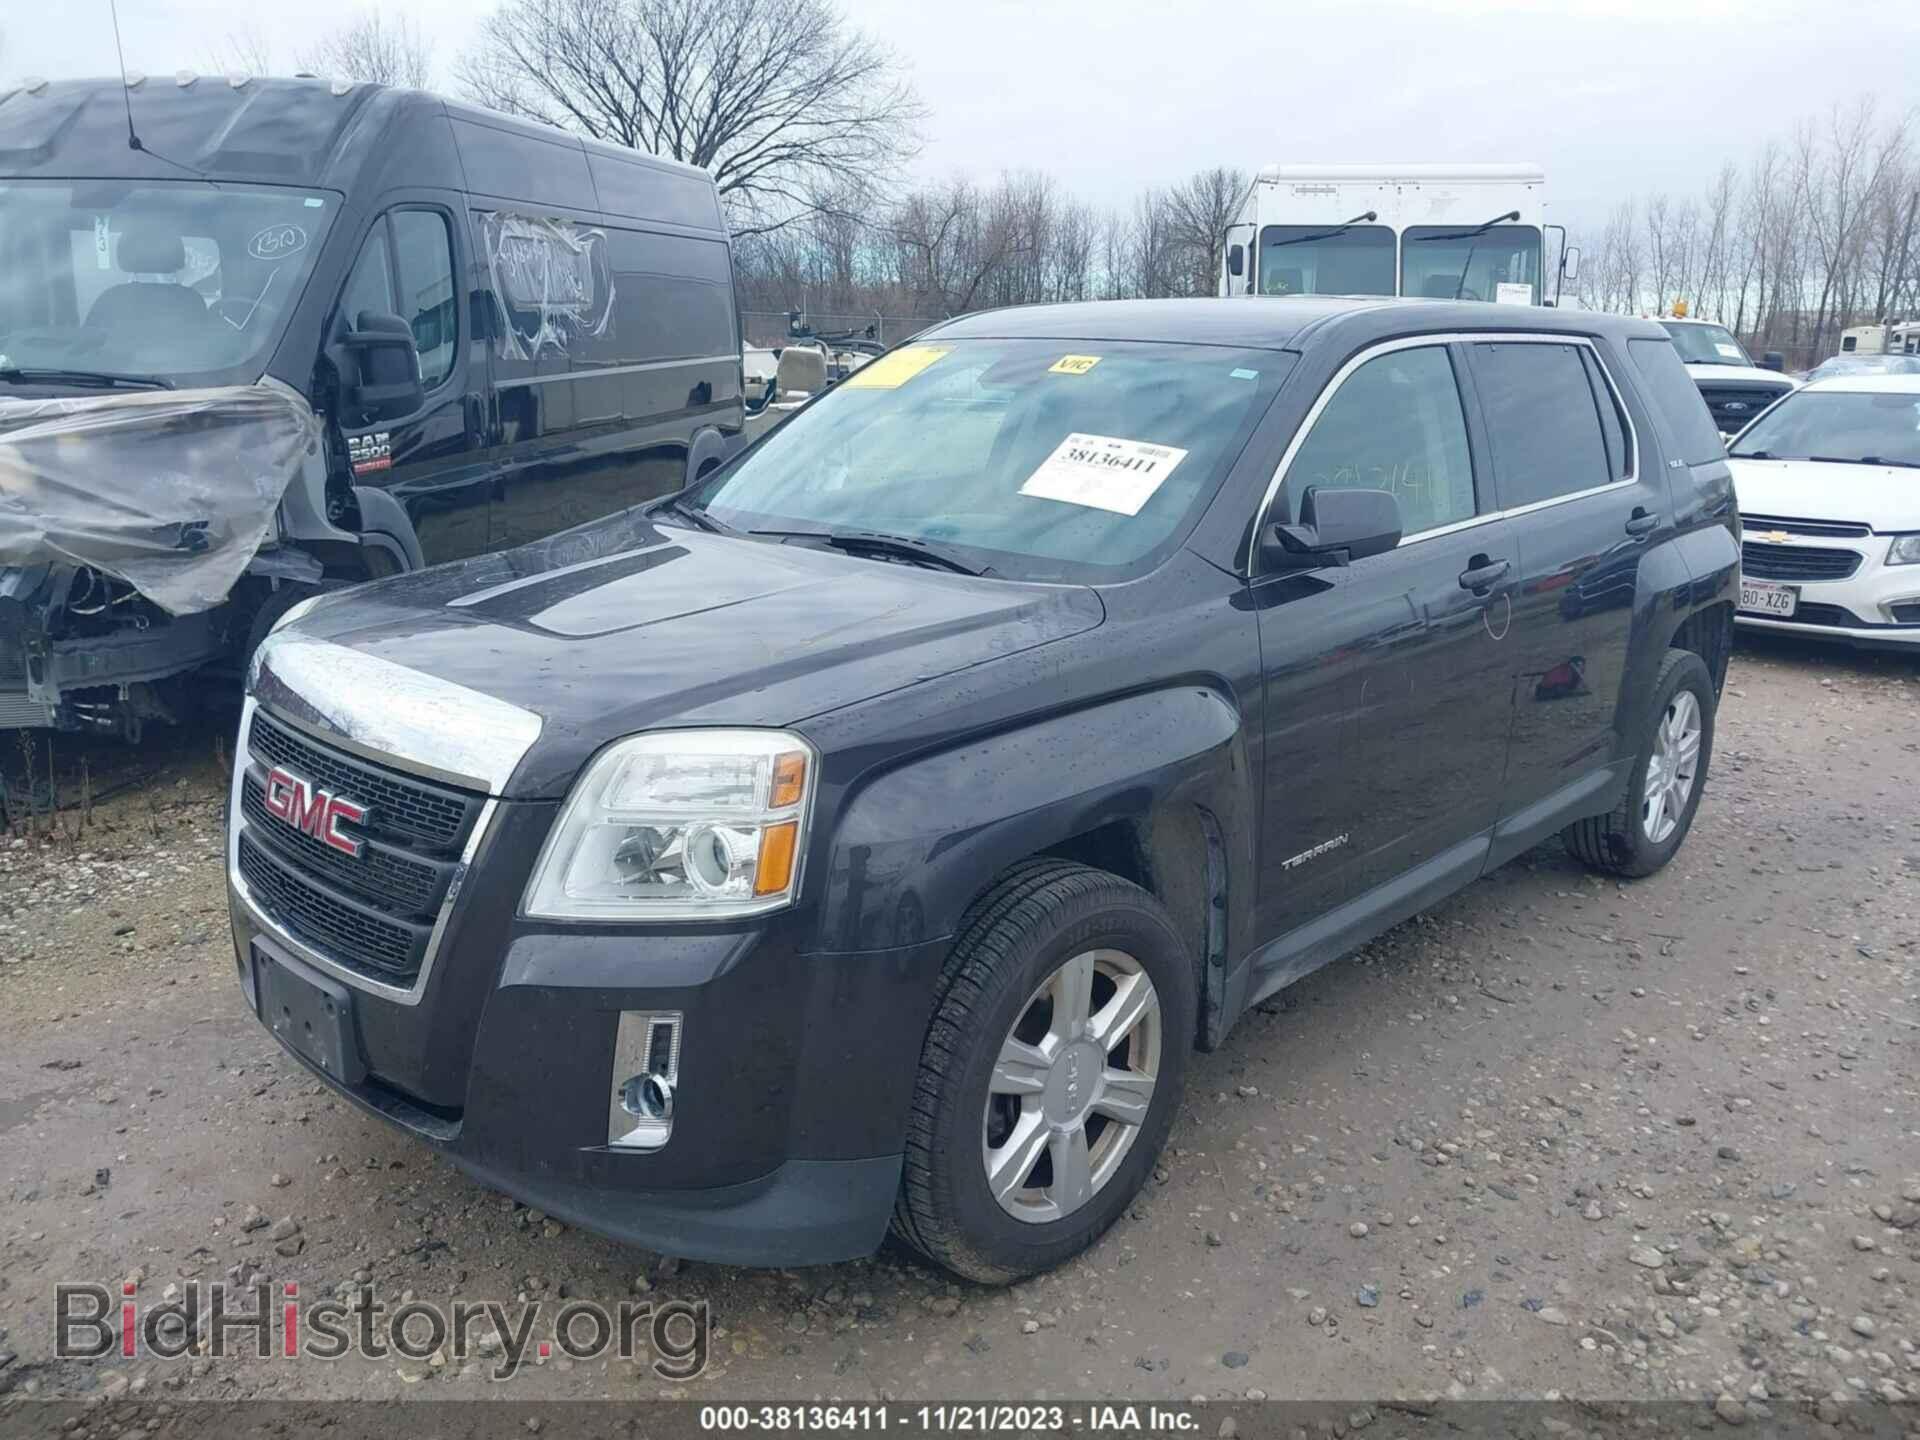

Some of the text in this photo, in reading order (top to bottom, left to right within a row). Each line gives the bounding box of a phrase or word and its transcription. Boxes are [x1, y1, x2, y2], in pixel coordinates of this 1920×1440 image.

[350, 444, 391, 462] 2500
[1060, 447, 1158, 474] 38136411
[265, 766, 370, 858] GMC
[1281, 832, 1349, 871] TERRAIN
